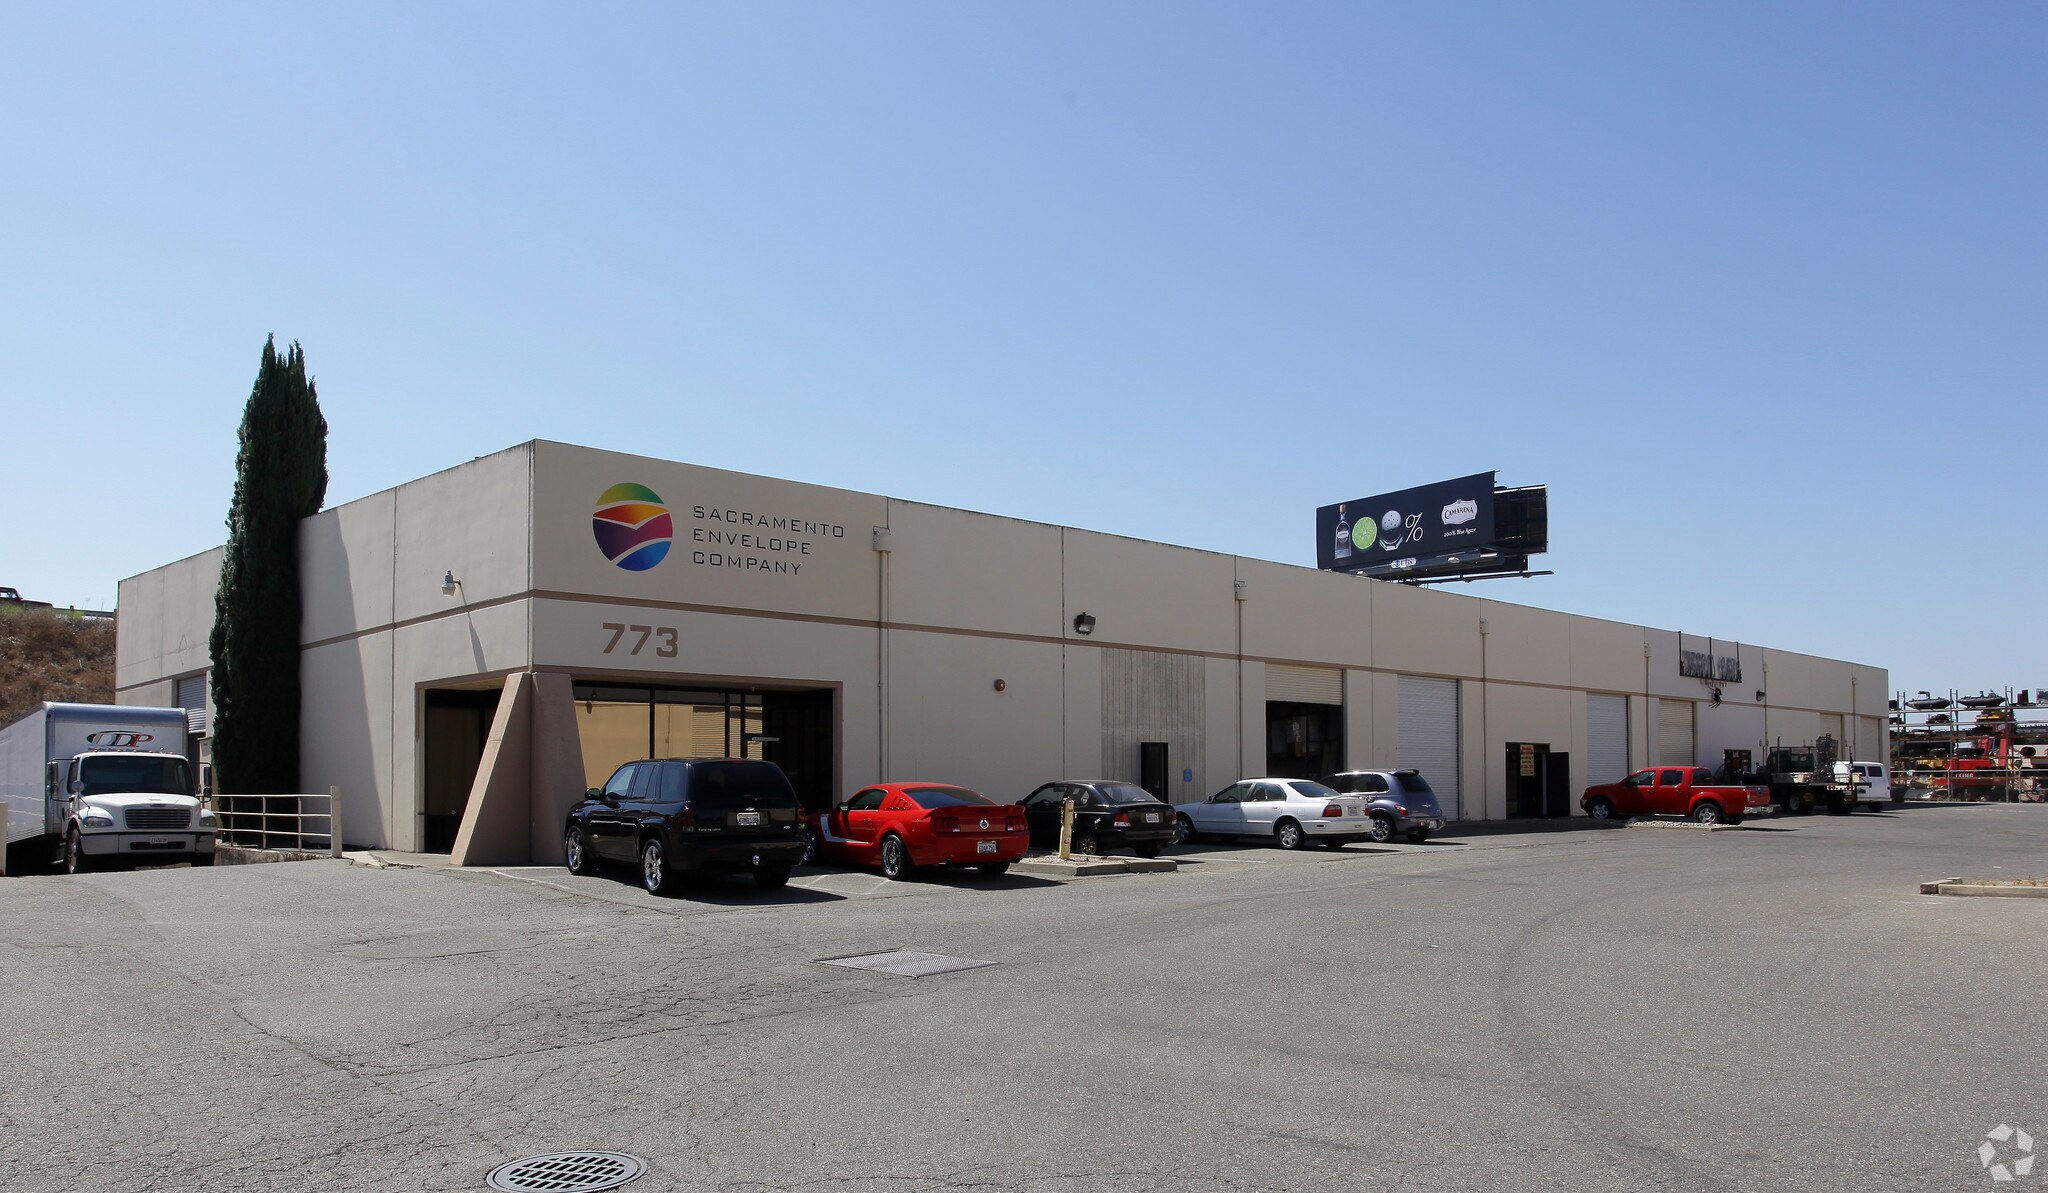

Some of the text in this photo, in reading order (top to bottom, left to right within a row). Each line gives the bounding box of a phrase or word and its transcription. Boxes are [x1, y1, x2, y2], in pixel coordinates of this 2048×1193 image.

[693, 505, 844, 538] SACRAMENTO
[693, 528, 812, 555] ENVELOPE
[693, 551, 802, 575] COMPANY
[602, 622, 679, 658] 773
